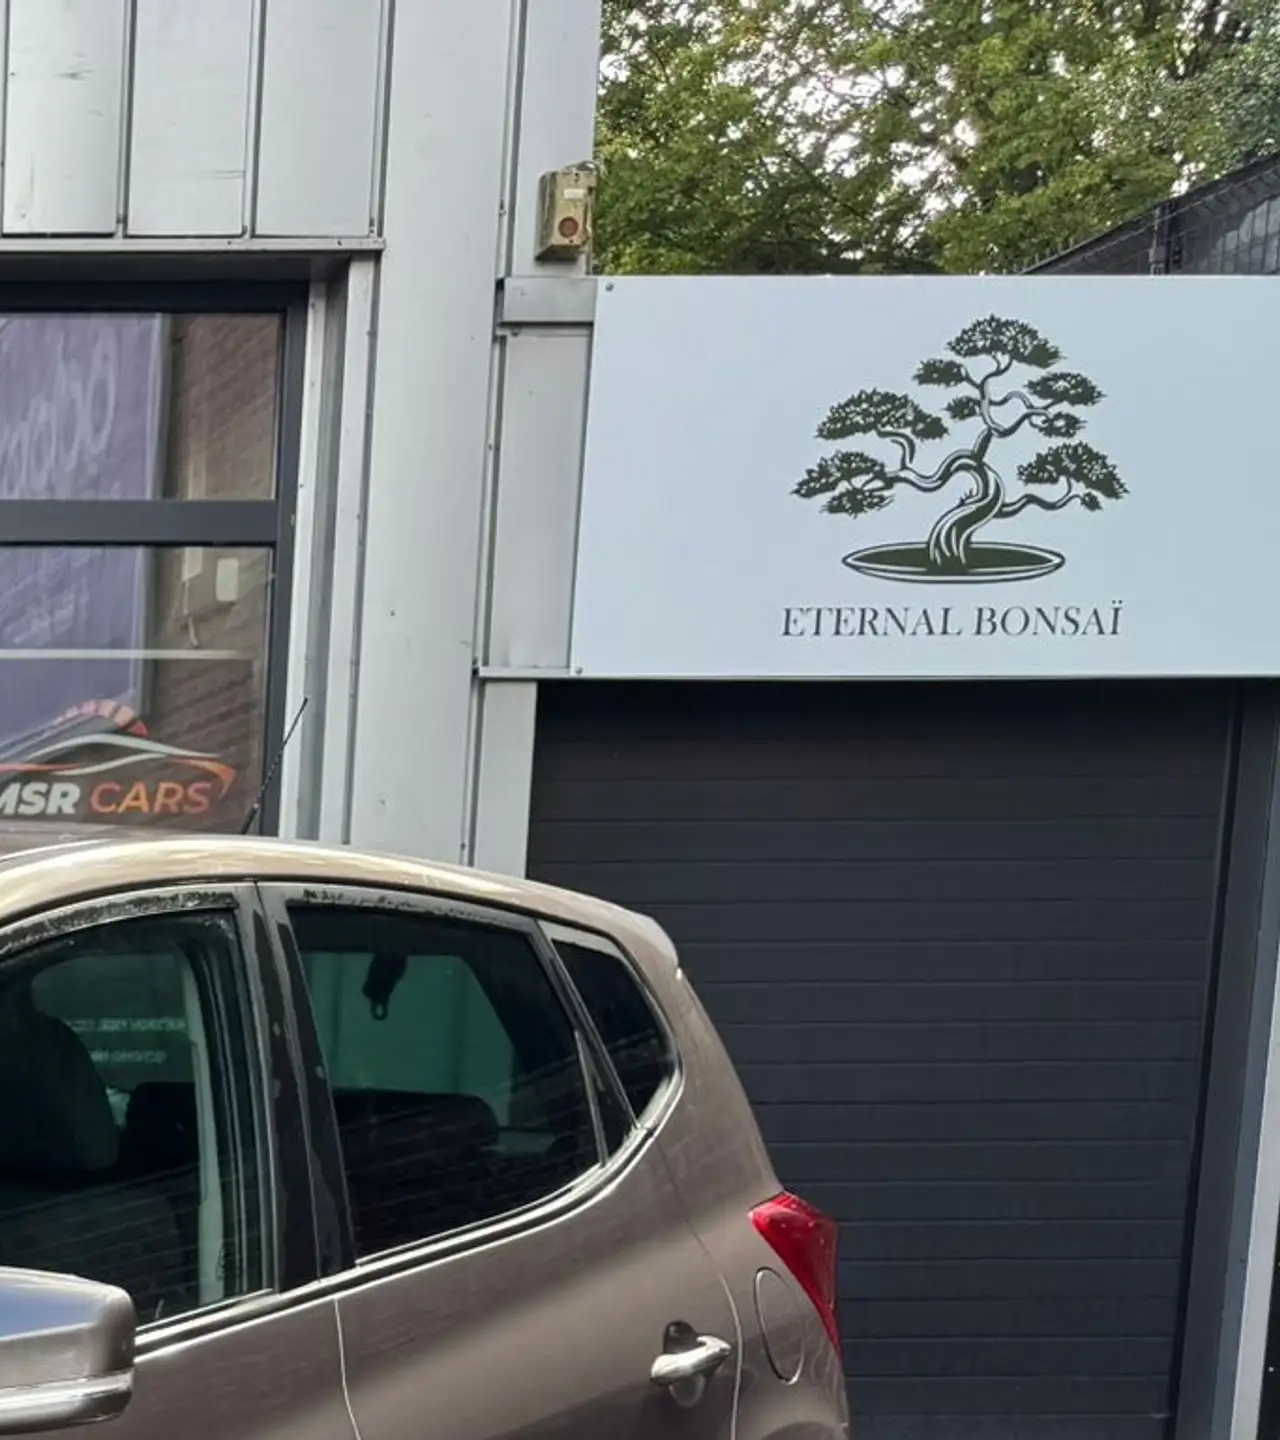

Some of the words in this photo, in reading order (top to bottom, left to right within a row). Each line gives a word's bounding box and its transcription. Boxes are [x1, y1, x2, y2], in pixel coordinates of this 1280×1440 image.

[782, 606, 962, 637] ETERNAL
[973, 600, 1124, 637] BONSAÏ
[91, 781, 212, 815] CARS
